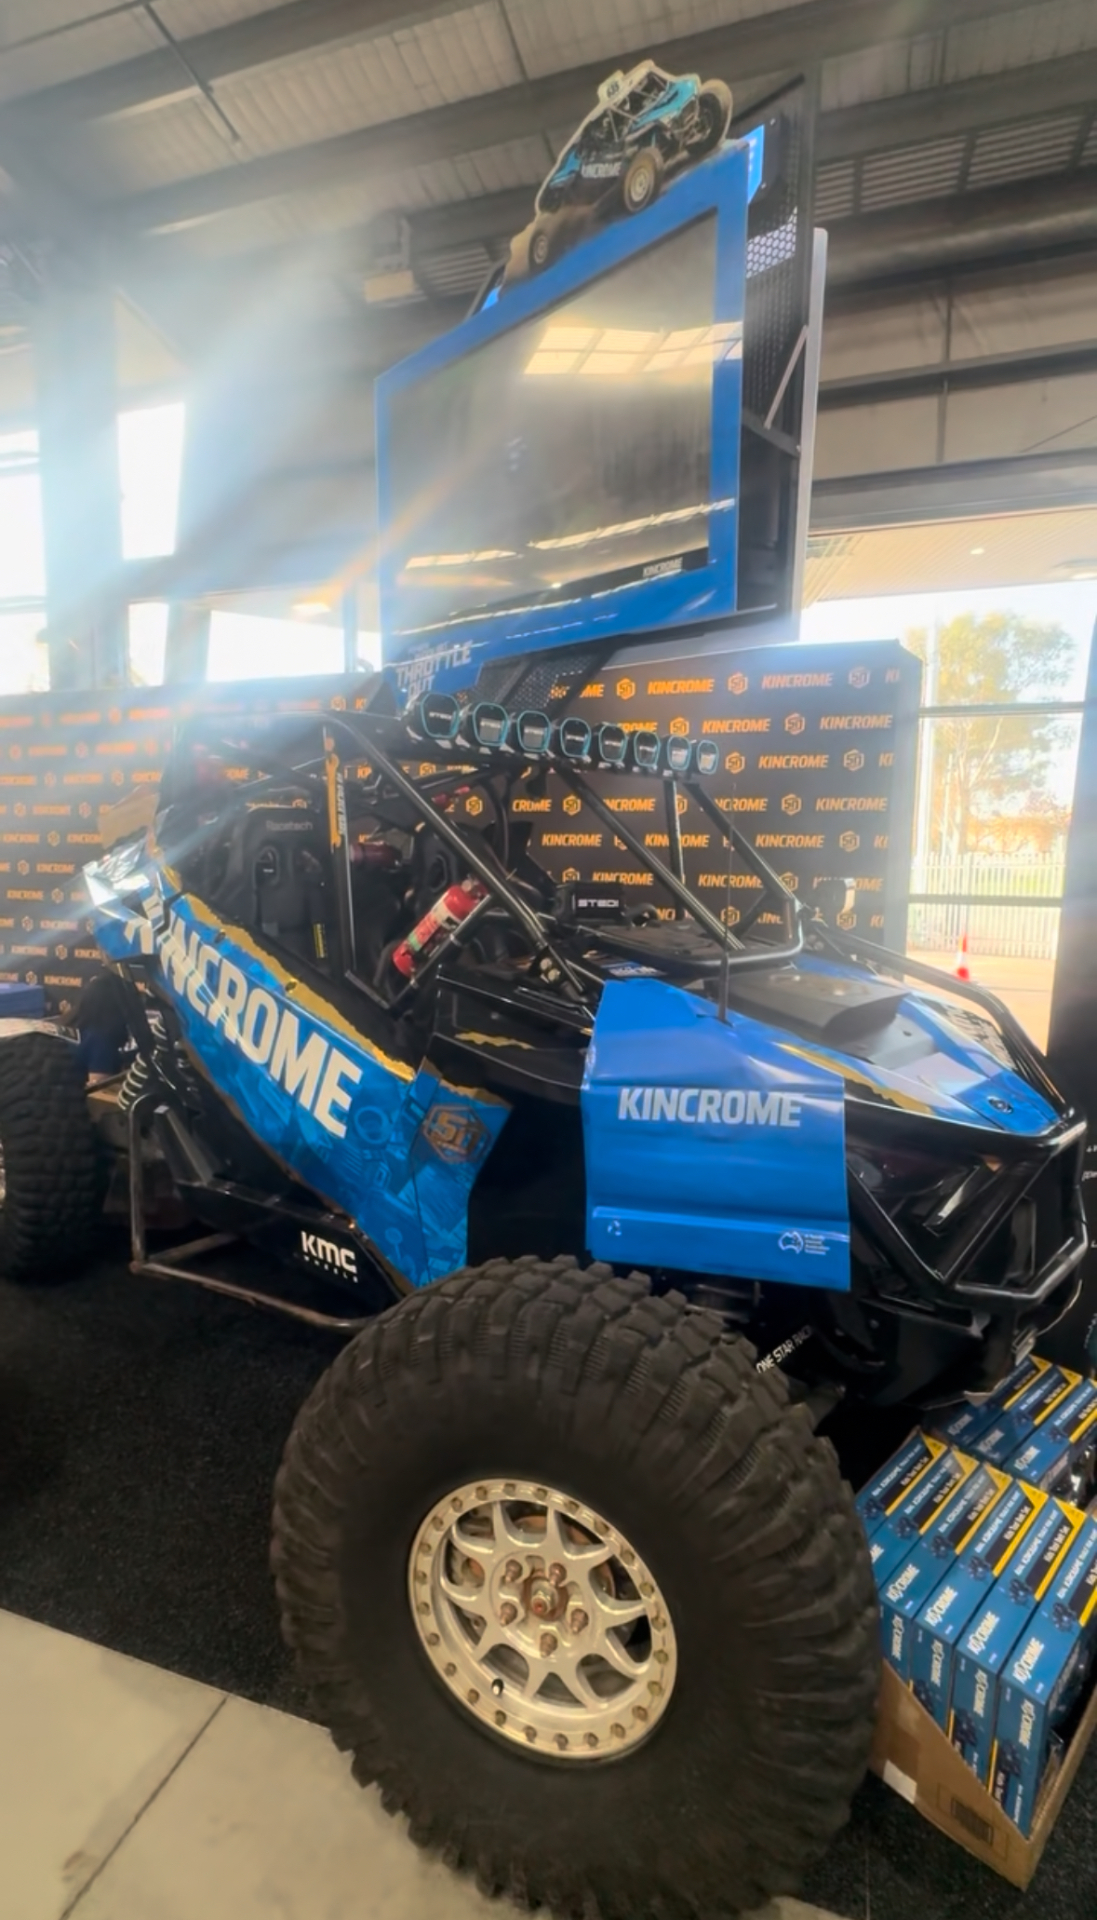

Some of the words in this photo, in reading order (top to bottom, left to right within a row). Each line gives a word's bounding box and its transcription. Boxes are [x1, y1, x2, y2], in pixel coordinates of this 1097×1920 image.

[647, 679, 715, 695] KINCROME
[761, 672, 835, 689] KINCROME
[702, 718, 771, 733] KINCROME
[820, 714, 893, 730] KINCROME
[758, 754, 829, 769] KINCROME
[512, 798, 552, 812] CROME
[603, 798, 656, 812] NCROME
[714, 798, 768, 811] NCROME
[816, 797, 888, 811] KINCROME
[542, 833, 602, 847] KINCROME
[644, 833, 710, 847] KINOME
[755, 834, 825, 848] KINCROME
[592, 872, 654, 885] KINCROME
[578, 898, 619, 908] STEDI
[124, 893, 363, 1138] KINCROME
[618, 1087, 802, 1127] KINCROME
[756, 1353, 775, 1374] ONE
[772, 1339, 796, 1363] STAR
